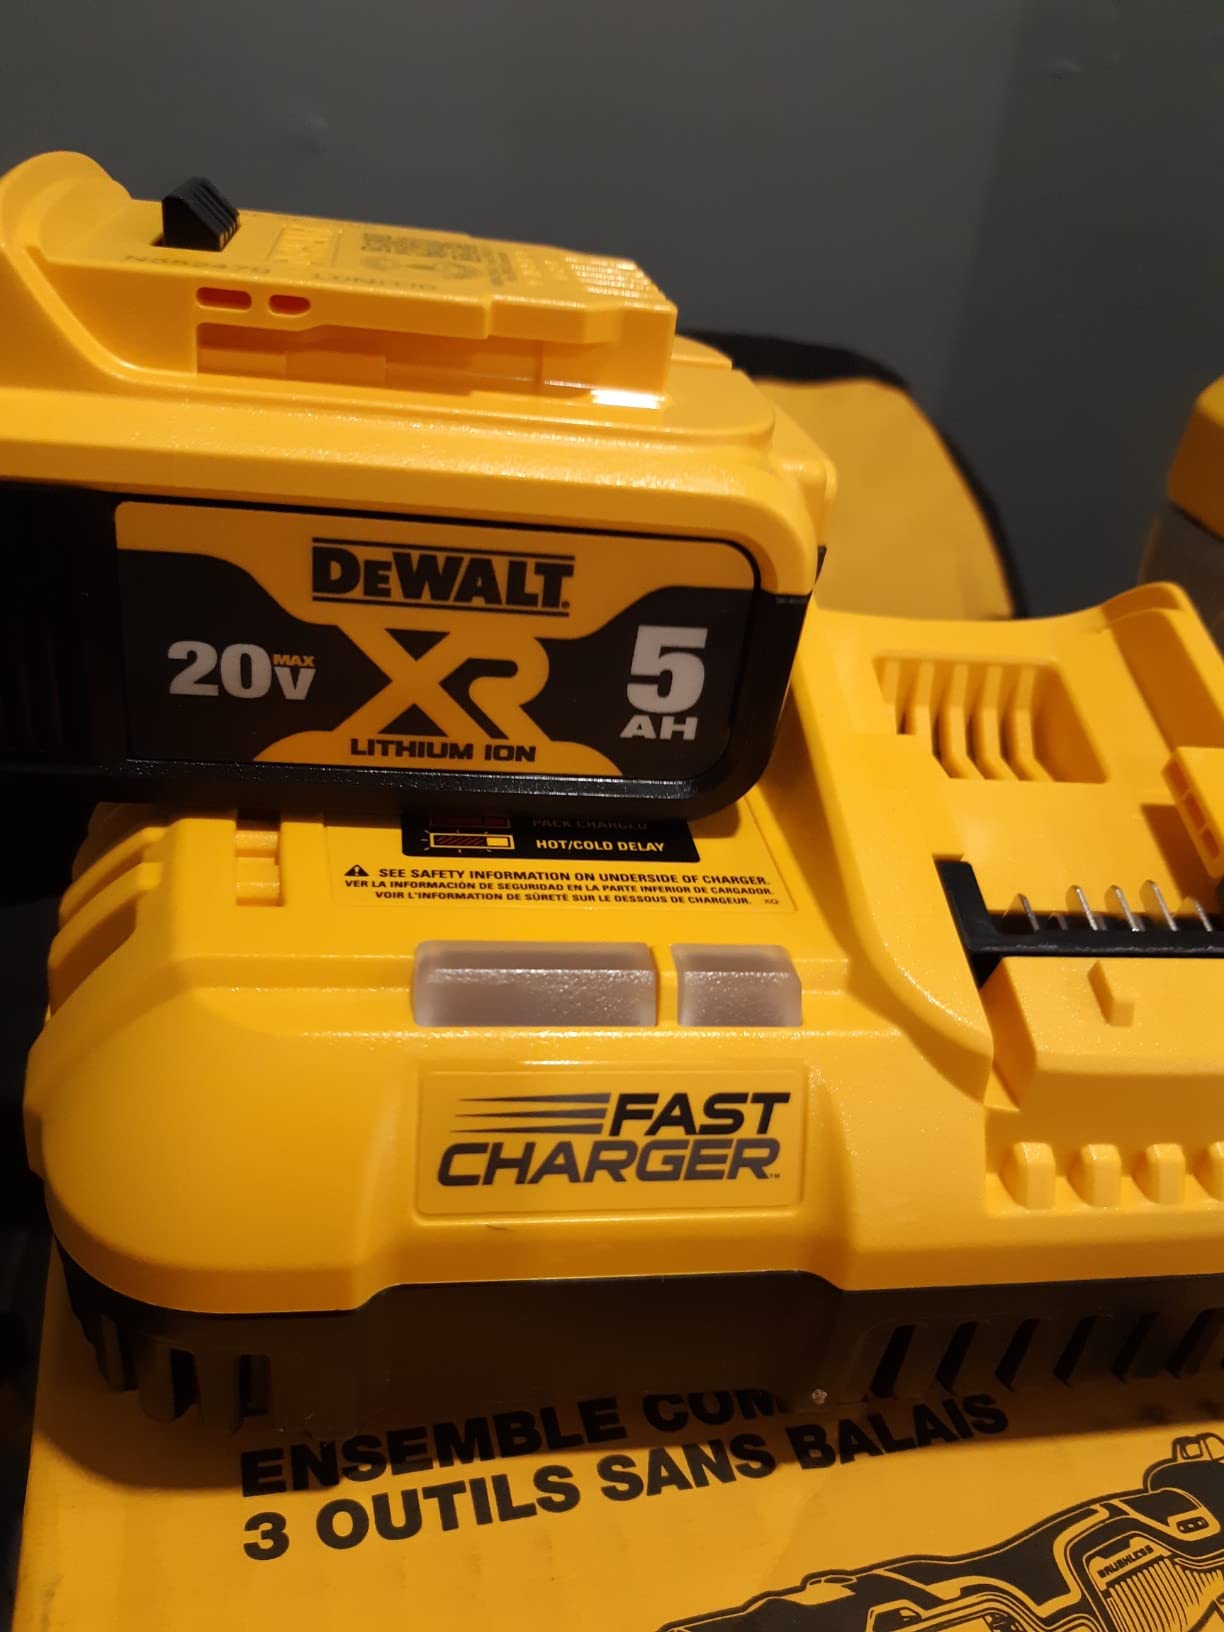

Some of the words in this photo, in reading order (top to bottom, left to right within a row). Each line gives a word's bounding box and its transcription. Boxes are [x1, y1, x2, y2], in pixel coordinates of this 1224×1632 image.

[311, 544, 573, 611] DEWALT
[273, 653, 314, 668] MAX
[626, 624, 708, 713] 5
[620, 715, 698, 741] AH
[350, 739, 474, 760] LITHIUM
[483, 745, 536, 762] ION
[536, 839, 613, 851] HOT/COLD
[617, 841, 665, 853] DELAY
[345, 879, 369, 889] VER
[372, 880, 387, 889] LA
[390, 879, 476, 890] INFORMACIÓN
[479, 883, 493, 891] DE
[497, 882, 564, 892] SEGURIDAD
[567, 884, 583, 893] EN
[585, 884, 600, 893] LA
[602, 885, 638, 894] PARTE
[640, 886, 691, 895] INFERIOR
[694, 887, 707, 896] DE
[710, 887, 773, 897] CARGADOR.
[379, 868, 407, 879] SEE
[411, 869, 466, 880] SAFETY
[469, 869, 570, 881] INFORMATION
[574, 872, 596, 882] ON
[599, 873, 678, 884] UNDERSIDE
[682, 875, 699, 885] OF
[702, 875, 771, 886] CHARGER.
[375, 890, 406, 900] VOIR
[408, 891, 503, 902] L'INFORMATION
[506, 893, 521, 902] DE
[572, 894, 596, 904] SUR
[599, 895, 612, 904] LE
[616, 895, 668, 905] DESSOUS
[670, 896, 685, 906] DE
[688, 896, 751, 907] CHARGEUR.
[608, 1092, 791, 1137] FAST
[437, 1138, 780, 1186] CHARGER
[240, 1397, 629, 1497] ENSEMBLE
[642, 1390, 790, 1431] COM
[243, 1511, 290, 1560] 3
[315, 1464, 581, 1550] OUTILS
[595, 1432, 776, 1502] SANS
[784, 1394, 1009, 1470] BALAIS
